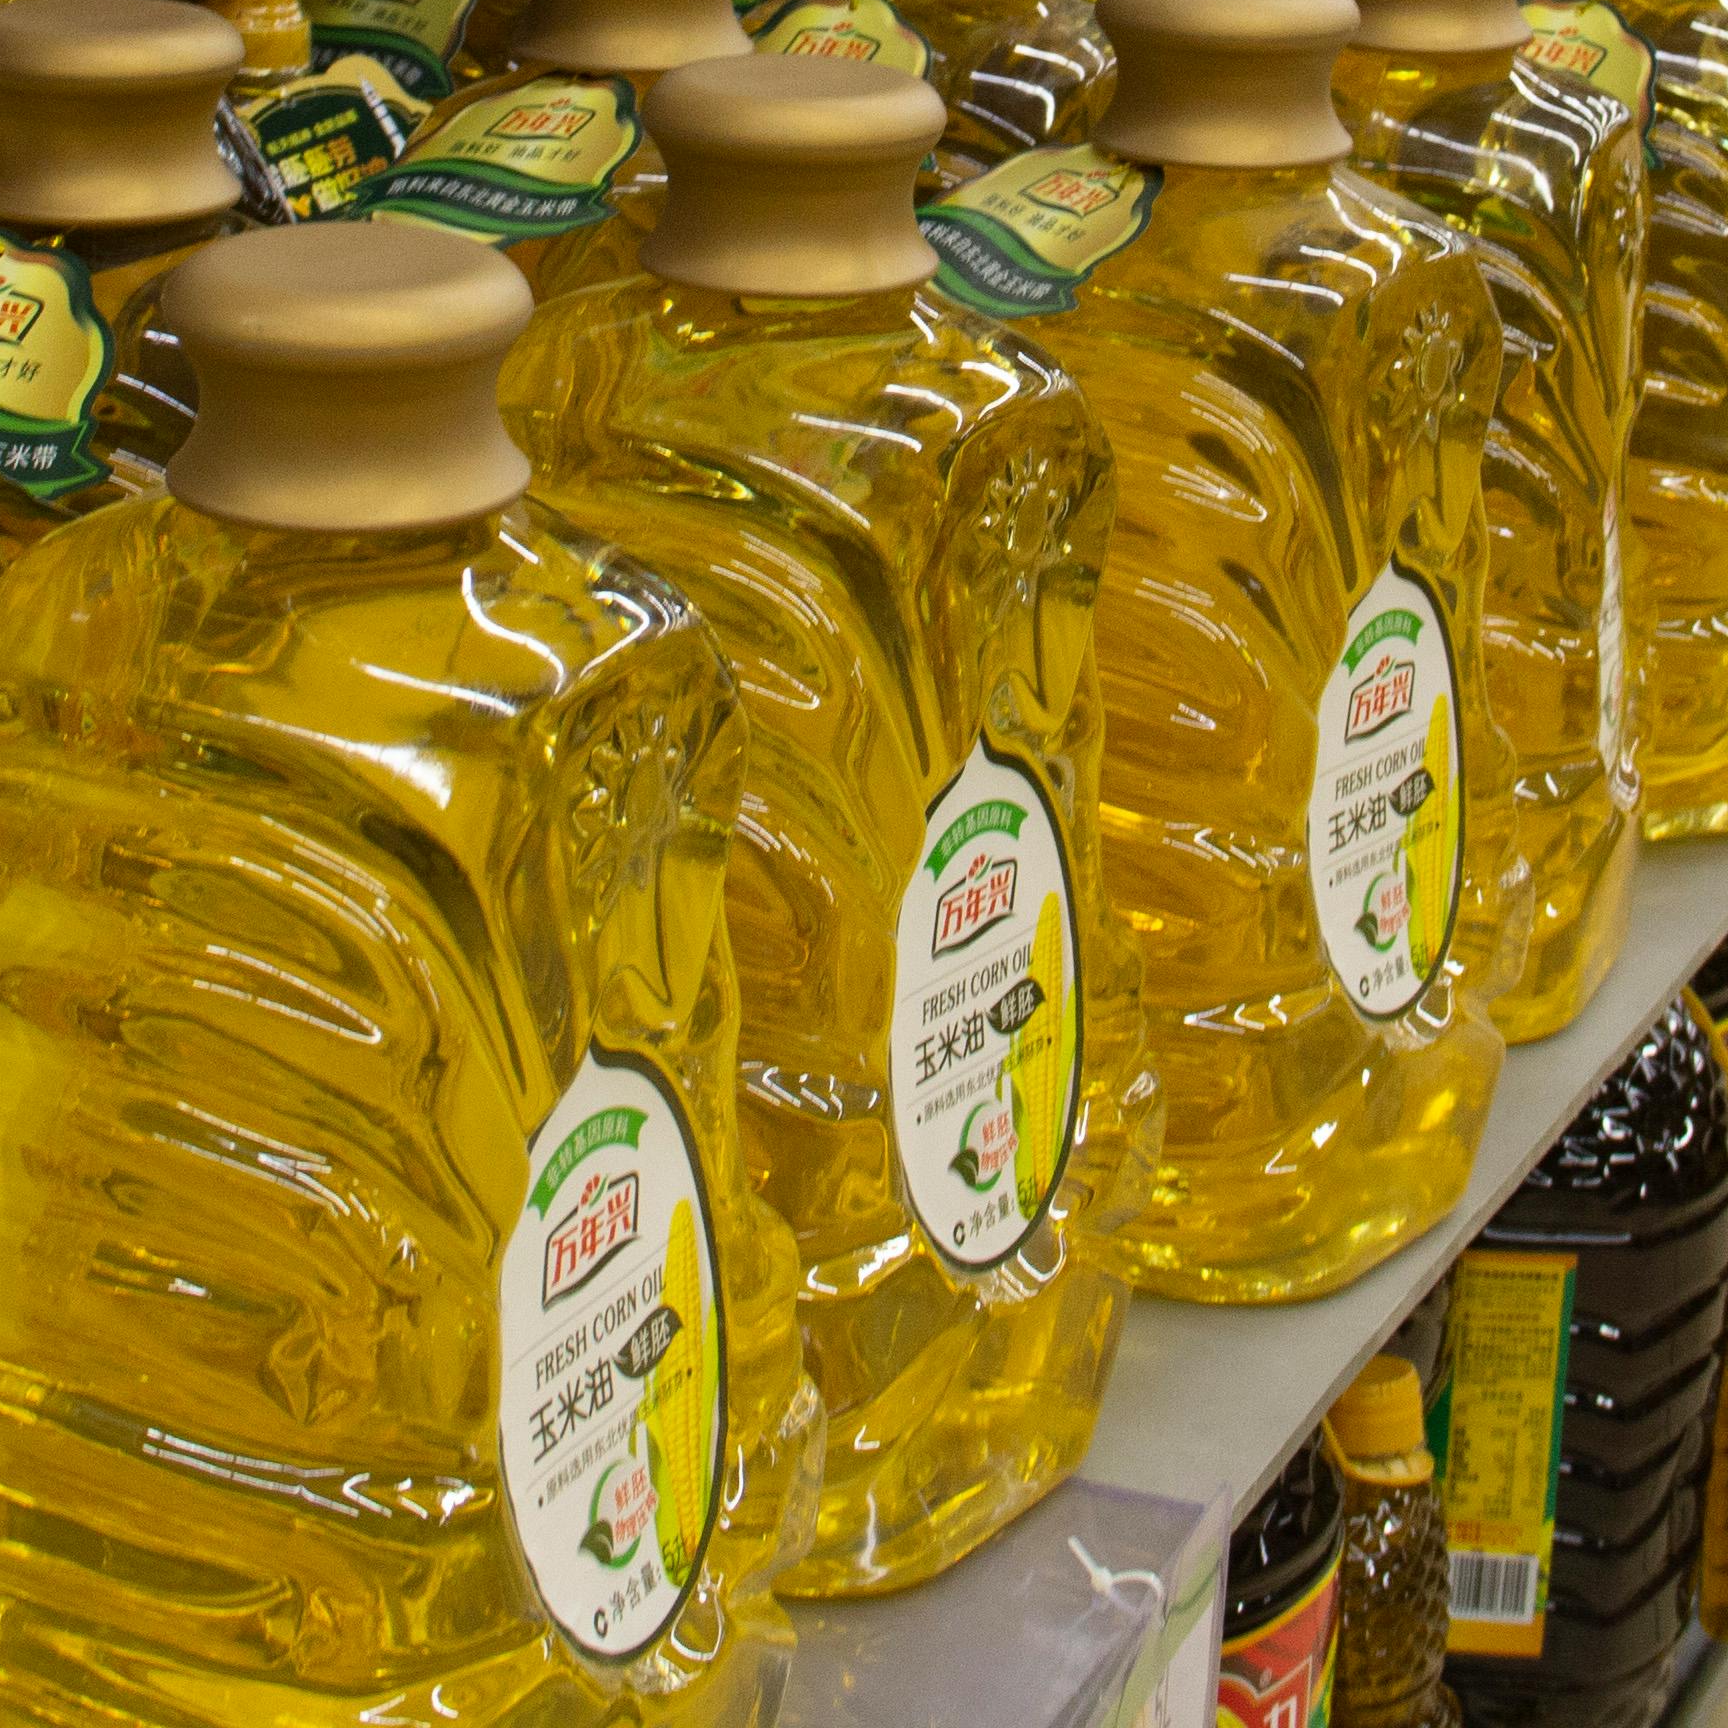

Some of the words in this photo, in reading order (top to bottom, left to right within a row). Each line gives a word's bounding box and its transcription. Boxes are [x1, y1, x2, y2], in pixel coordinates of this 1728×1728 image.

[1352, 669, 1410, 730] 万年兴
[1335, 766, 1373, 801] FRESH
[1375, 745, 1408, 784] CORN
[1328, 791, 1389, 855] 玉米油
[940, 866, 1012, 942] 万年兴
[922, 978, 967, 1027] FRESH
[970, 956, 1009, 998] CORN
[1012, 941, 1034, 973] OIL
[914, 1008, 986, 1087] 玉米油
[551, 1182, 632, 1289] 万年兴
[535, 1324, 589, 1391] FRESH
[592, 1285, 638, 1345] CORN
[641, 1262, 667, 1305] OIL
[528, 1355, 615, 1465] 玉米油
